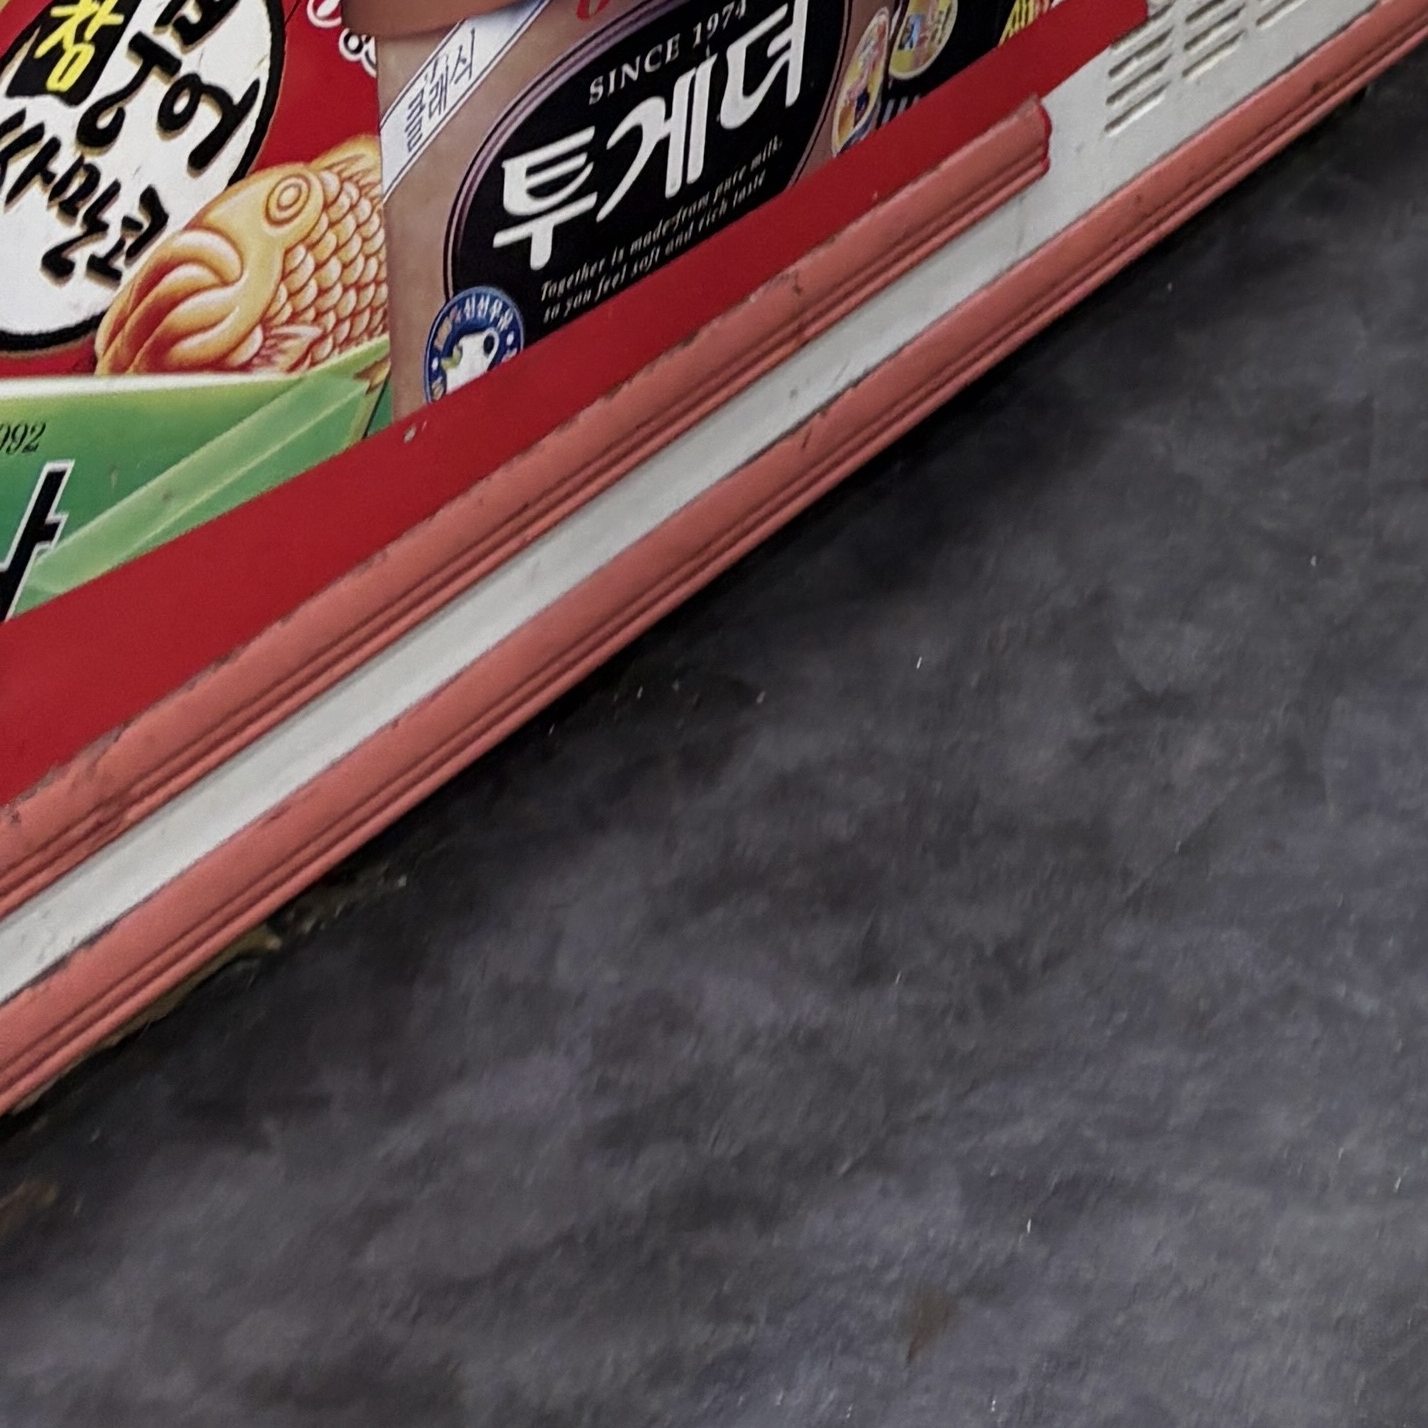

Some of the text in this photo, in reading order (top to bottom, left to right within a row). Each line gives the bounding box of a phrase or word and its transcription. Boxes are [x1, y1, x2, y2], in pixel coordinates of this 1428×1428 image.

[401, 27, 477, 153] 클래식
[589, 35, 684, 107] SINCE
[540, 252, 607, 303] Together
